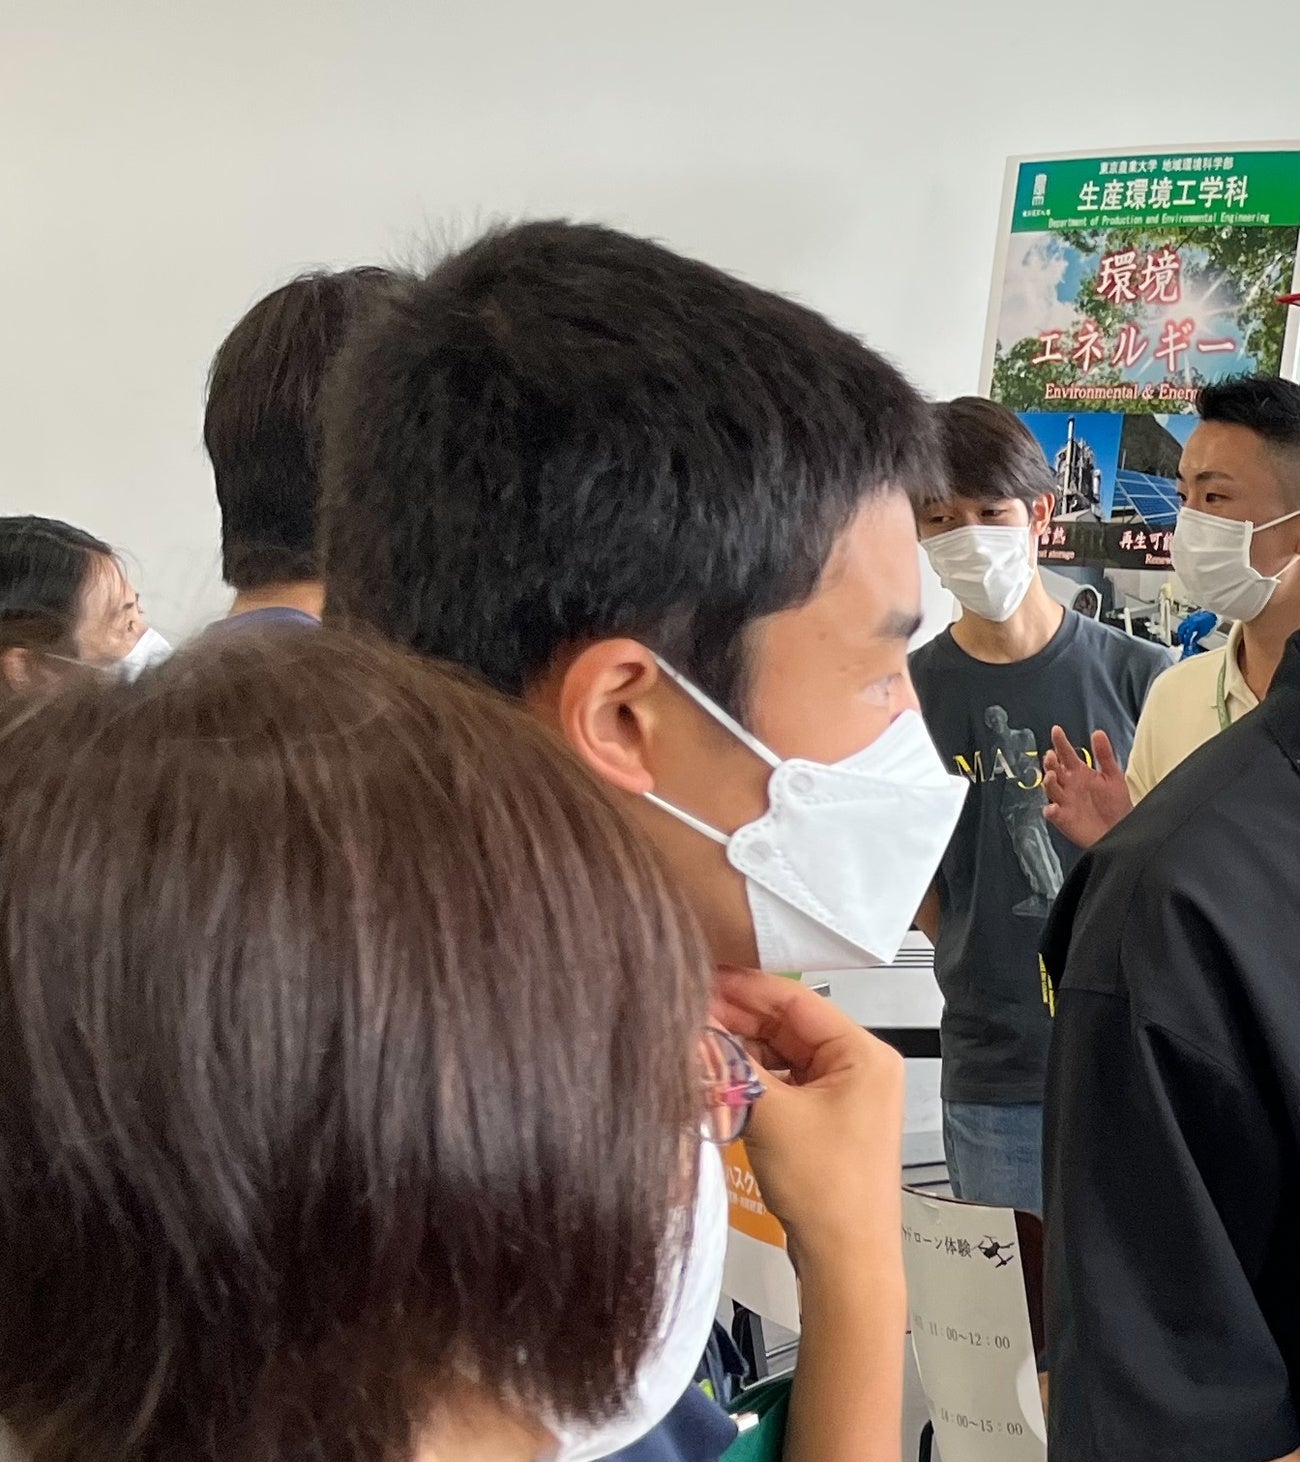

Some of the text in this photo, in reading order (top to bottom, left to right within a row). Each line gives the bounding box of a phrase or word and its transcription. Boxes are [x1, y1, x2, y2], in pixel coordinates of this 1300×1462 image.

[1077, 175, 1249, 211] 生産環境工学科
[1102, 215, 1143, 226] Production
[1146, 214, 1159, 224] and
[1161, 212, 1217, 224] Environmental
[1221, 211, 1270, 224] Engineering
[1096, 250, 1181, 303] 環境
[1032, 322, 1236, 373] エネルギー
[1045, 383, 1138, 400] Environmental
[1142, 383, 1155, 400] &
